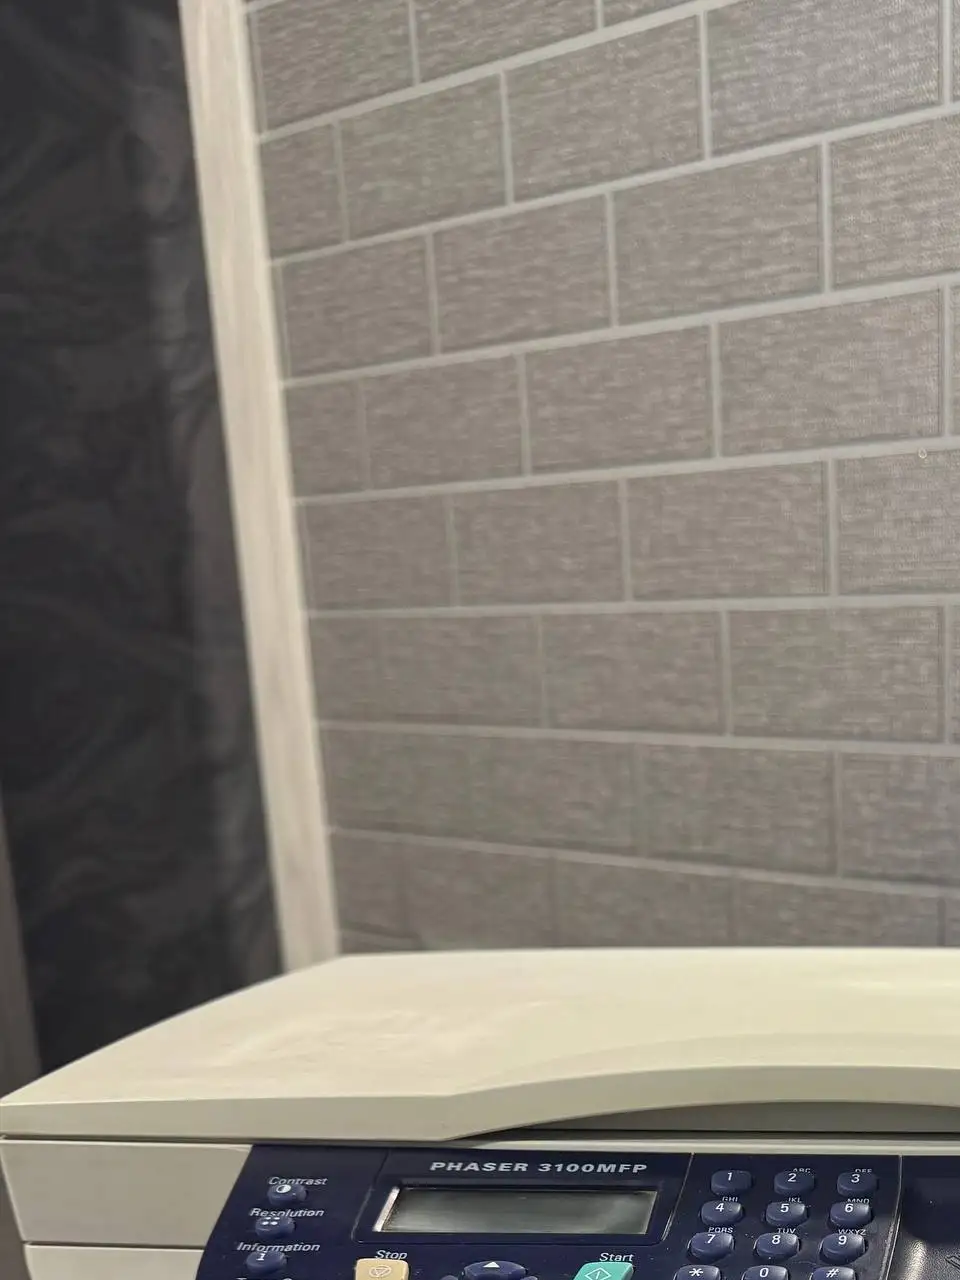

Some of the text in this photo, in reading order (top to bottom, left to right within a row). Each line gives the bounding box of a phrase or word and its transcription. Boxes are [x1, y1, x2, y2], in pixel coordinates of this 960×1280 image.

[429, 1162, 648, 1173] PHASER 3100MFP
[268, 1176, 328, 1186] Contrast
[788, 1173, 797, 1182] 2
[851, 1174, 860, 1183] 3
[715, 1203, 725, 1212] 4
[780, 1204, 789, 1213] 5
[844, 1204, 854, 1213] 6
[249, 1208, 324, 1217] Resolution
[707, 1235, 716, 1244] 7
[772, 1235, 781, 1245] 8
[838, 1236, 847, 1245] 9
[237, 1242, 320, 1251] Information
[375, 1250, 408, 1260] Stop
[599, 1252, 635, 1262] Start
[759, 1268, 768, 1278] 0
